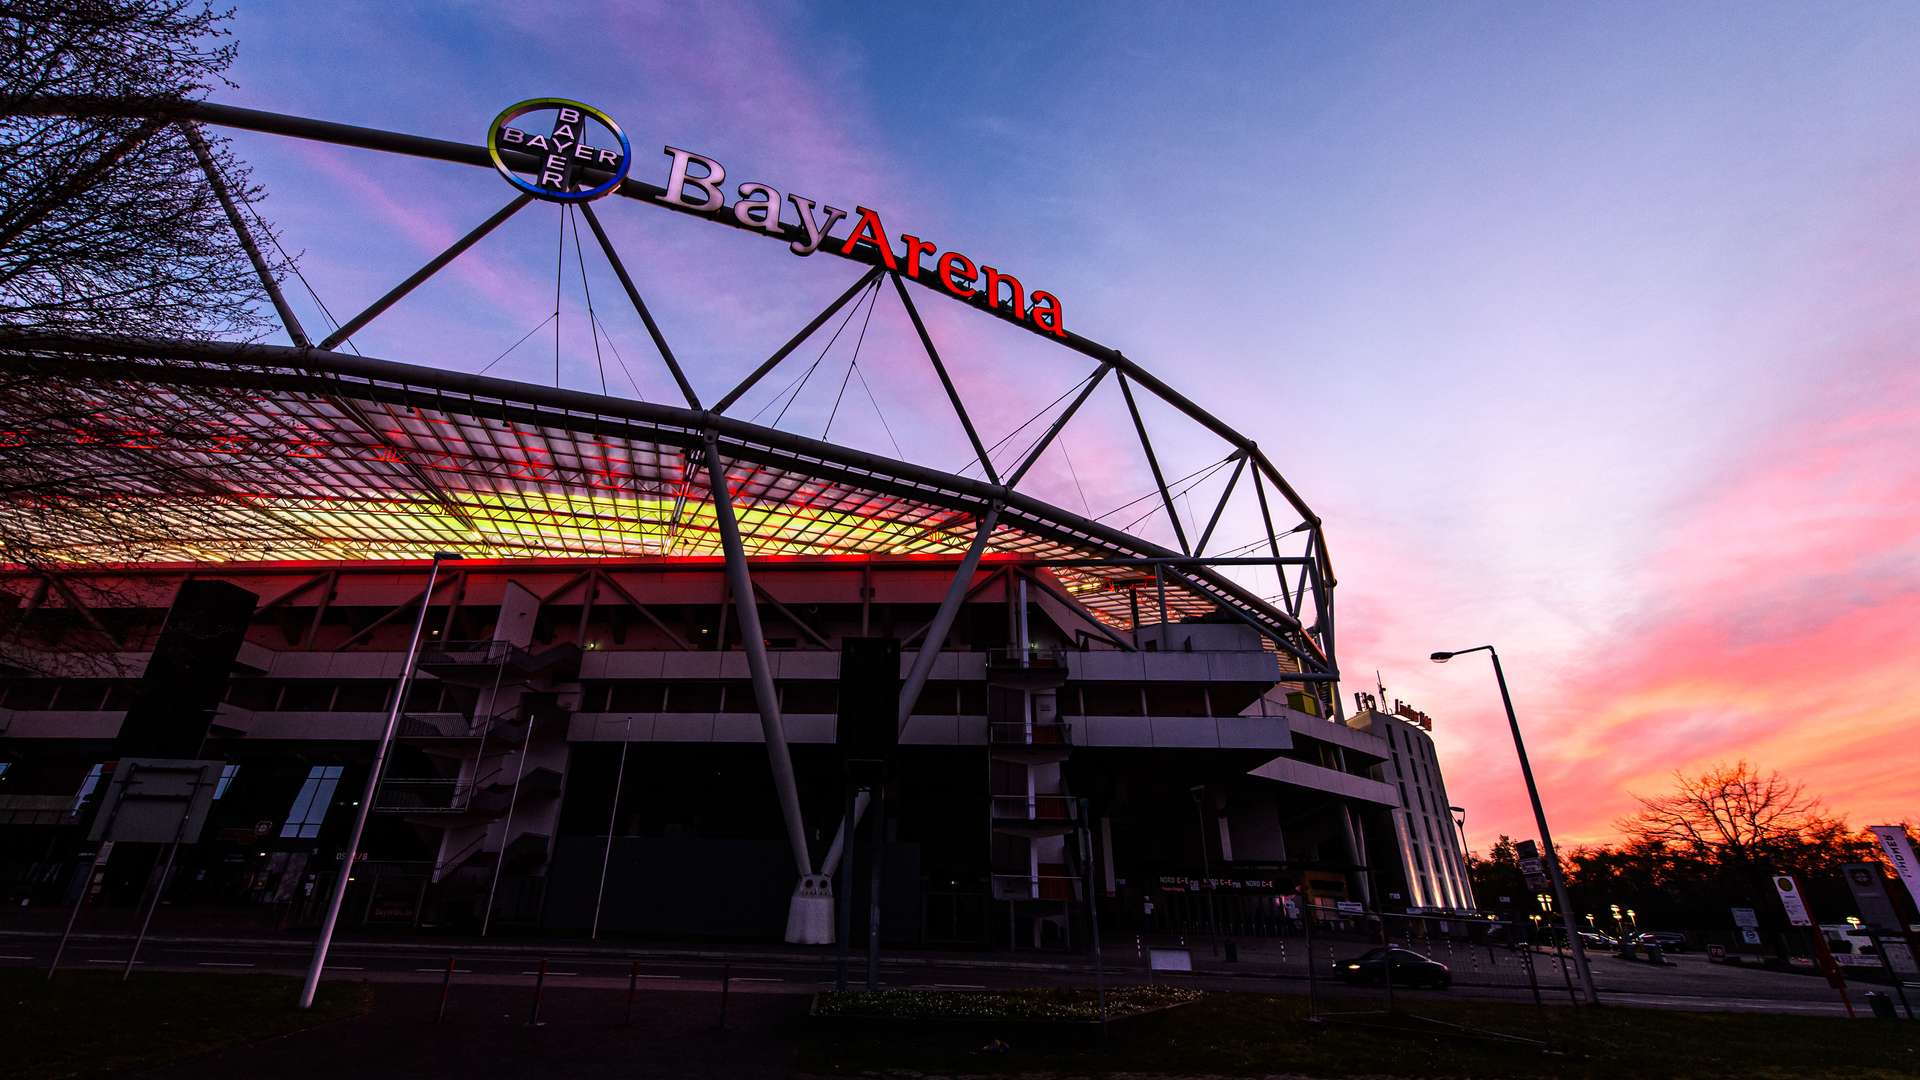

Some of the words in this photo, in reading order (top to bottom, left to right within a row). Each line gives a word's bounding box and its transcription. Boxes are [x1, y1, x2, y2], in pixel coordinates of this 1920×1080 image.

[503, 127, 618, 166] BAYER
[541, 107, 580, 189] BAYER
[654, 145, 1068, 338] BayArena
